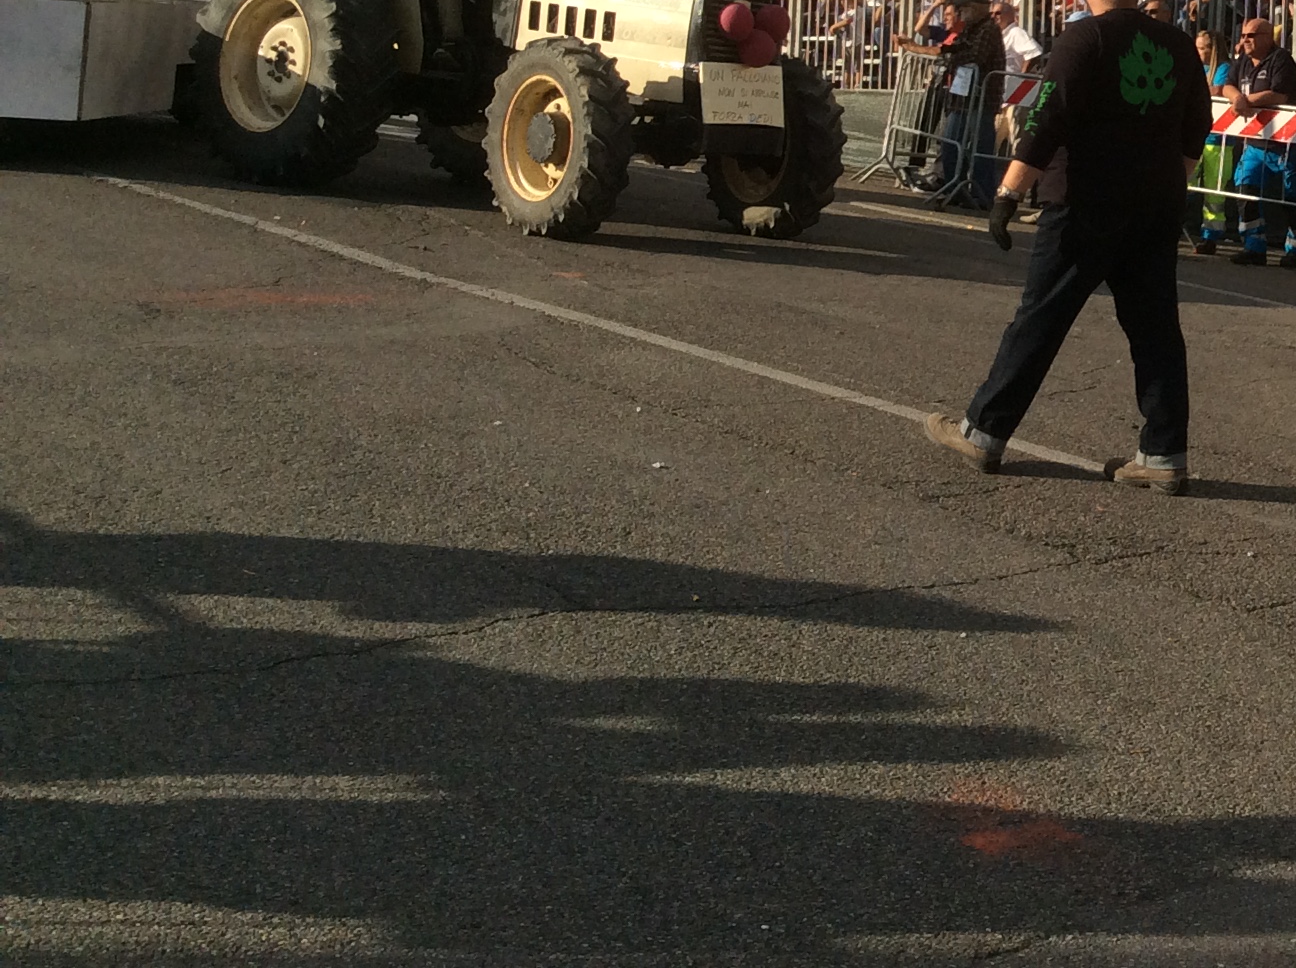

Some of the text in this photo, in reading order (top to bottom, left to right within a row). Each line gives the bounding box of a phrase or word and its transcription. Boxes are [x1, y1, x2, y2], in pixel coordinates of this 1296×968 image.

[709, 70, 724, 82] UN
[718, 87, 736, 97] NON
[712, 111, 744, 121] FORZA
